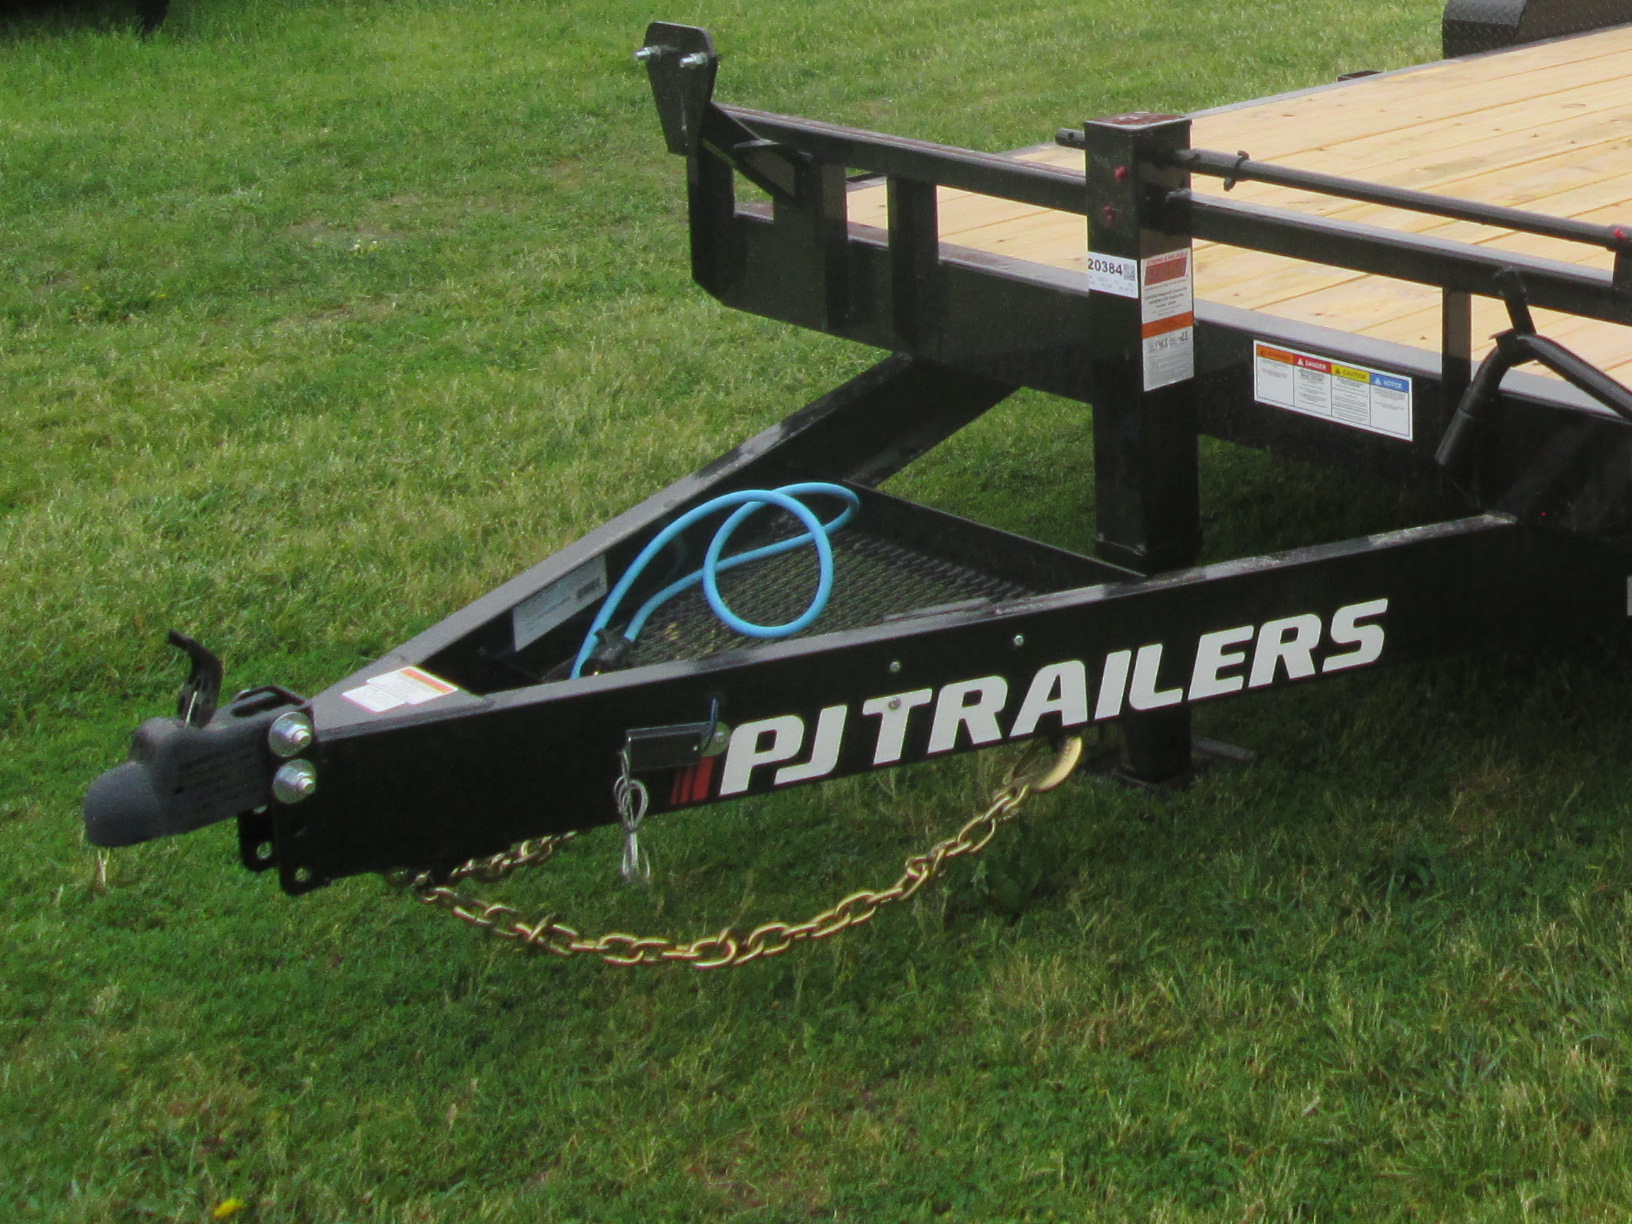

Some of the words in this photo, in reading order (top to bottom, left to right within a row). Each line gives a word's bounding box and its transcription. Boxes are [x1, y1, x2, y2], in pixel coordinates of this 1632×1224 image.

[1088, 258, 1123, 276] 20384
[1305, 360, 1327, 371] DANGER
[718, 704, 848, 795] PJ
[862, 598, 1388, 766] TRAILERS
